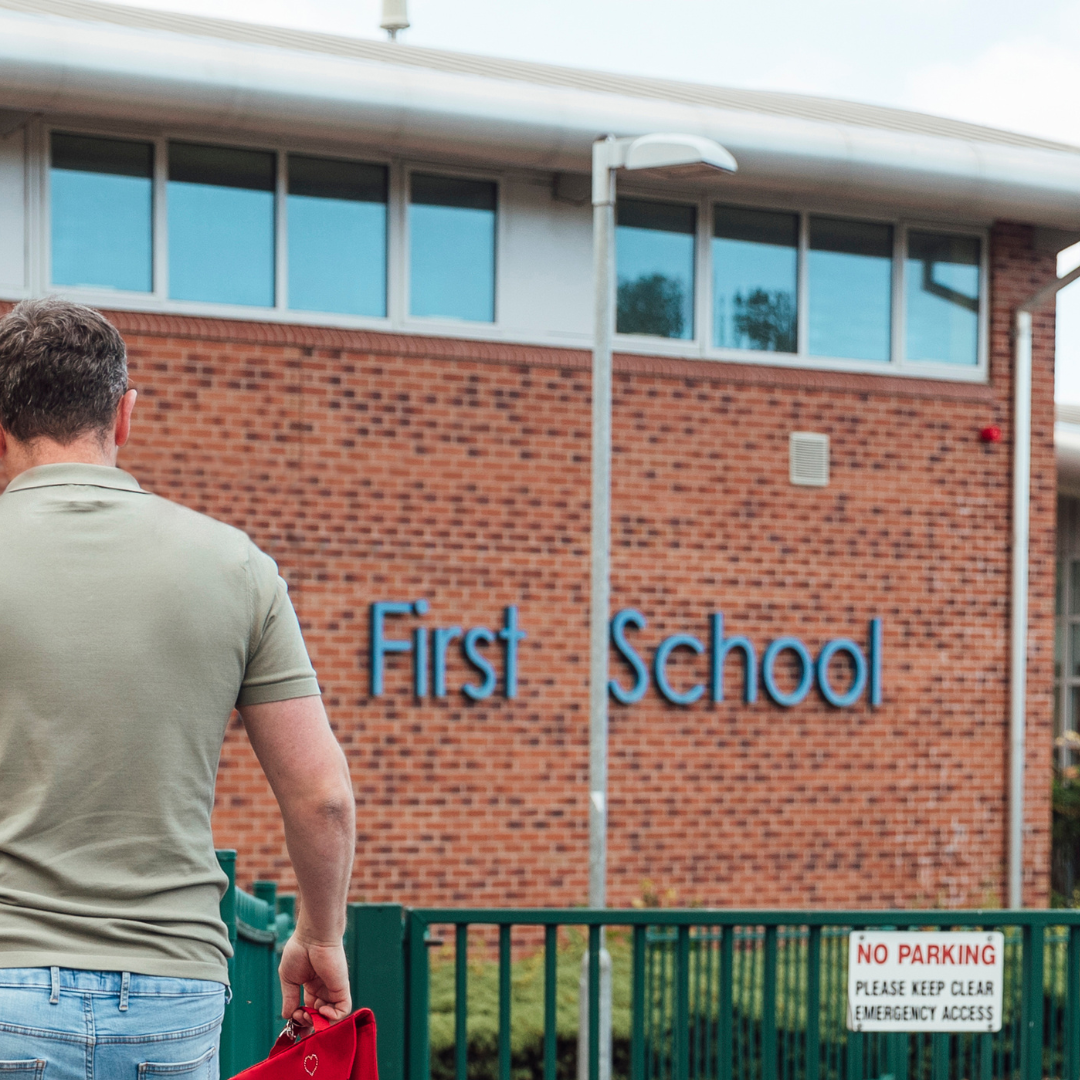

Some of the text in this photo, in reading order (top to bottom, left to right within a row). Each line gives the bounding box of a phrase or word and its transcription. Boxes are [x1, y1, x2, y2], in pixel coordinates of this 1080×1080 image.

[370, 599, 883, 707] First School
[857, 943, 996, 965] NO PARKING
[855, 980, 994, 996] PLEASE KEEP CLEAR
[855, 1005, 994, 1021] EMERGENCY ACCESS
